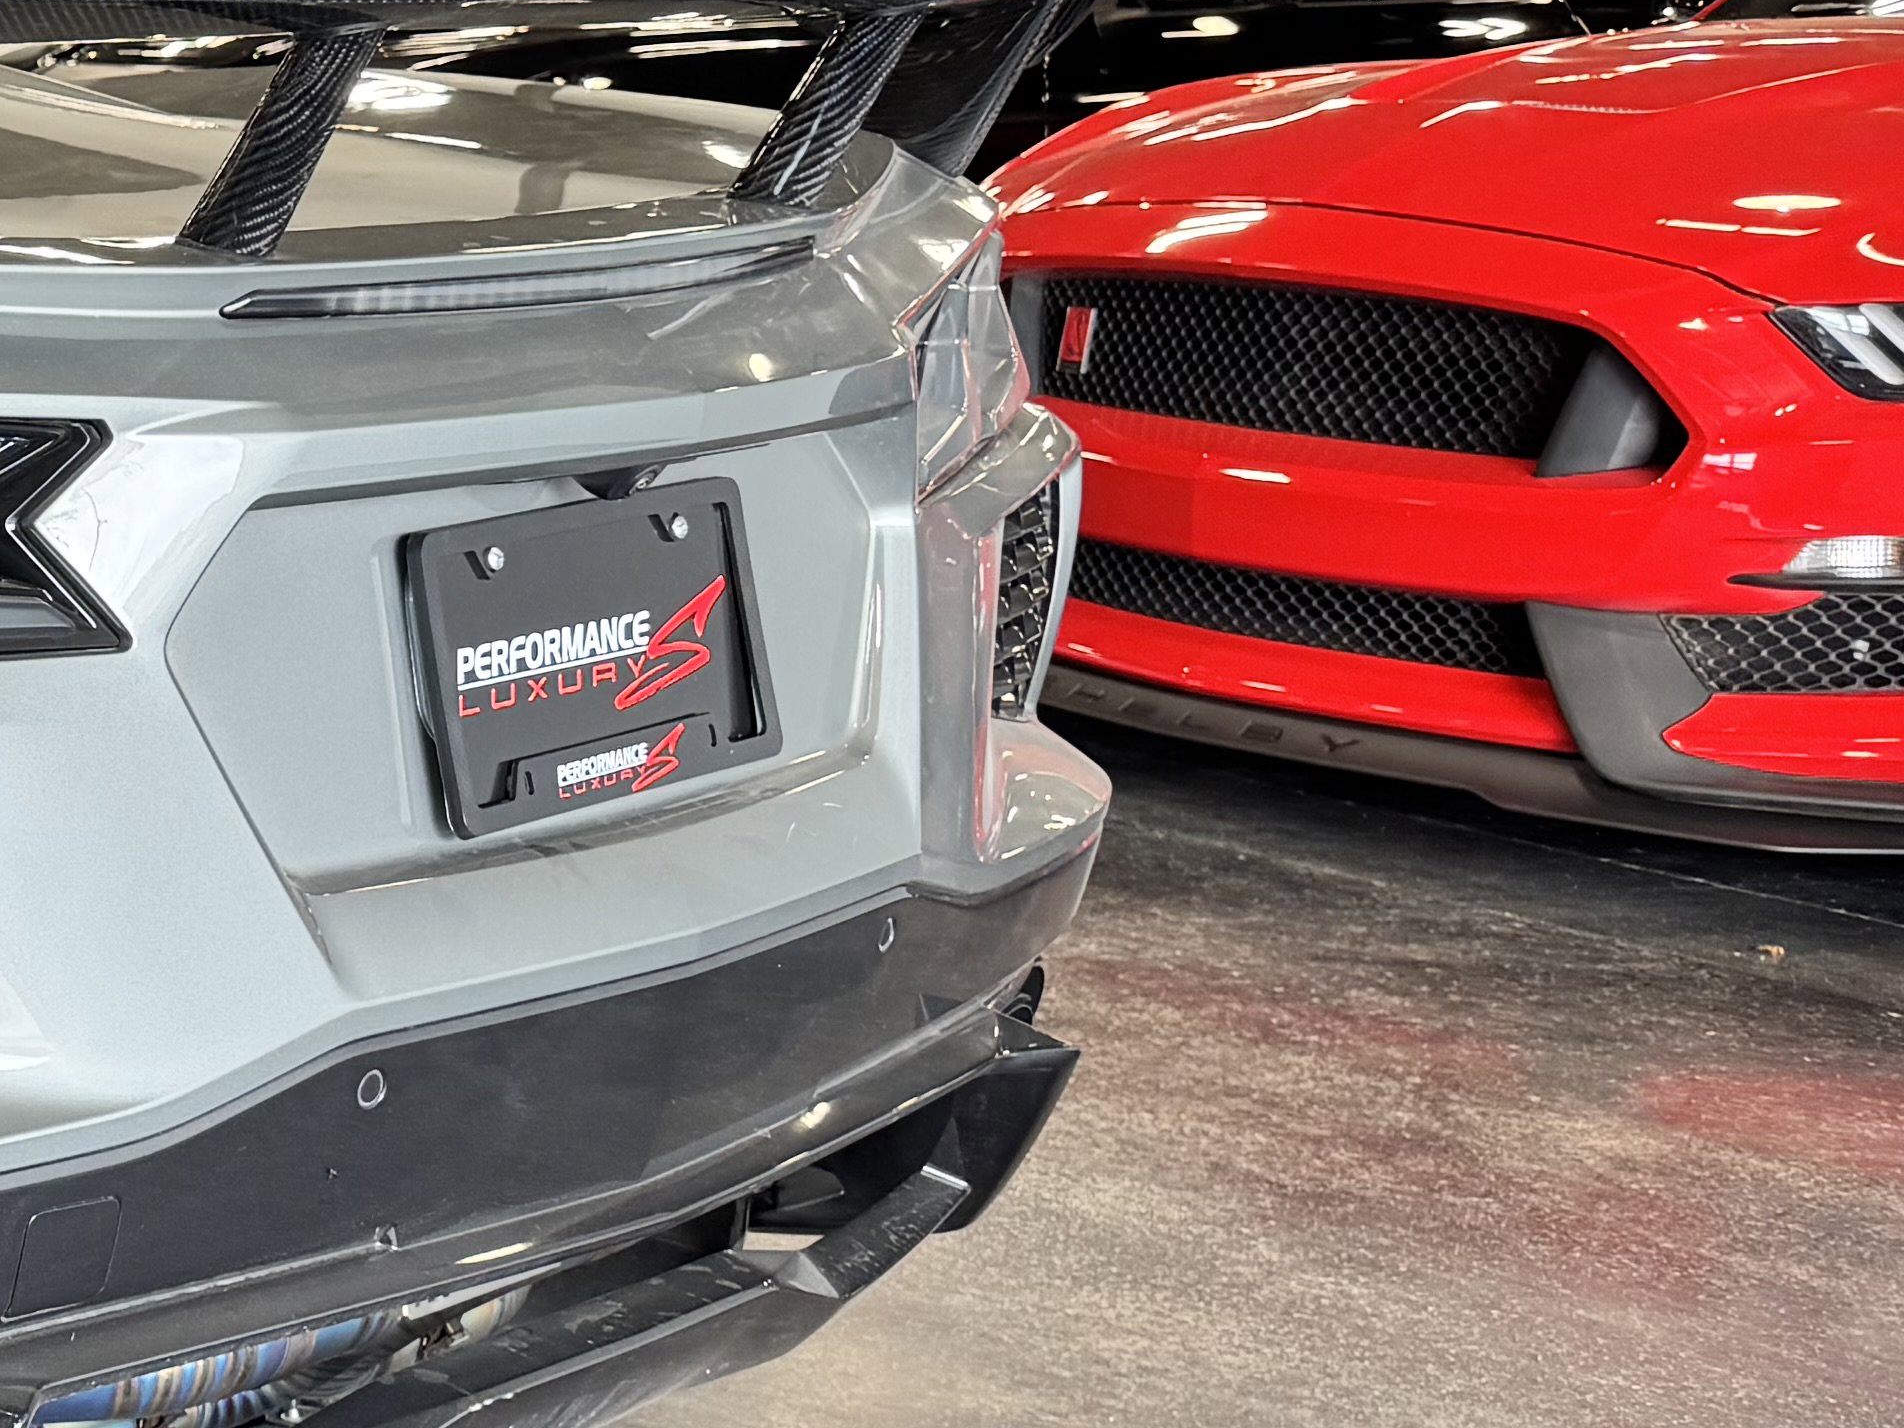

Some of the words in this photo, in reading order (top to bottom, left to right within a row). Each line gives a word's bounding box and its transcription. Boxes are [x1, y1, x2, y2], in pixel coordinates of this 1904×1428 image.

[456, 609, 651, 685] PERFORMANCE
[458, 654, 647, 717] LUXURY
[1045, 680, 1361, 754] HELBY
[557, 742, 648, 785] PERFORMANCE
[558, 765, 646, 800] LUXURY
